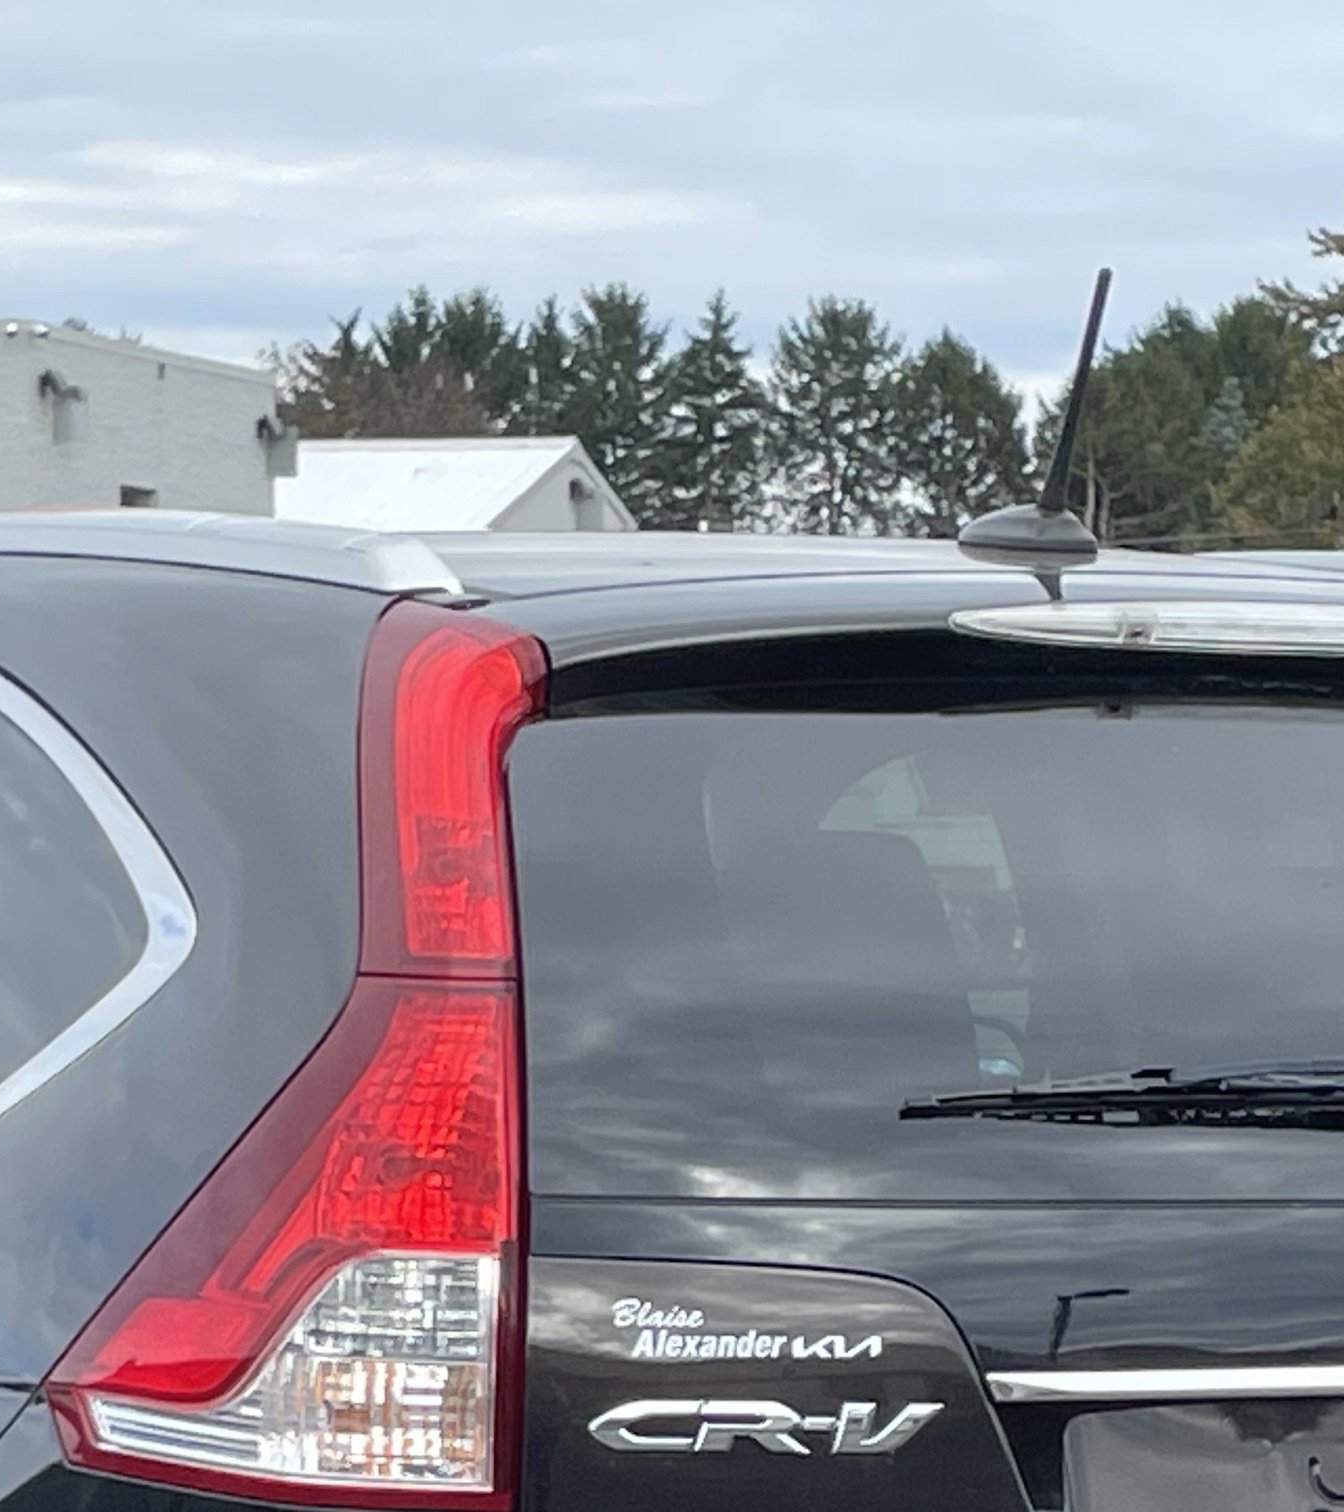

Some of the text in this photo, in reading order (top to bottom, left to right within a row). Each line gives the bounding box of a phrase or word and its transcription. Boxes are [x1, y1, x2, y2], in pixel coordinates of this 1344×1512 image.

[612, 1298, 704, 1328] Blaise
[631, 1329, 788, 1359] Alexander
[588, 1399, 946, 1454] CR-V
